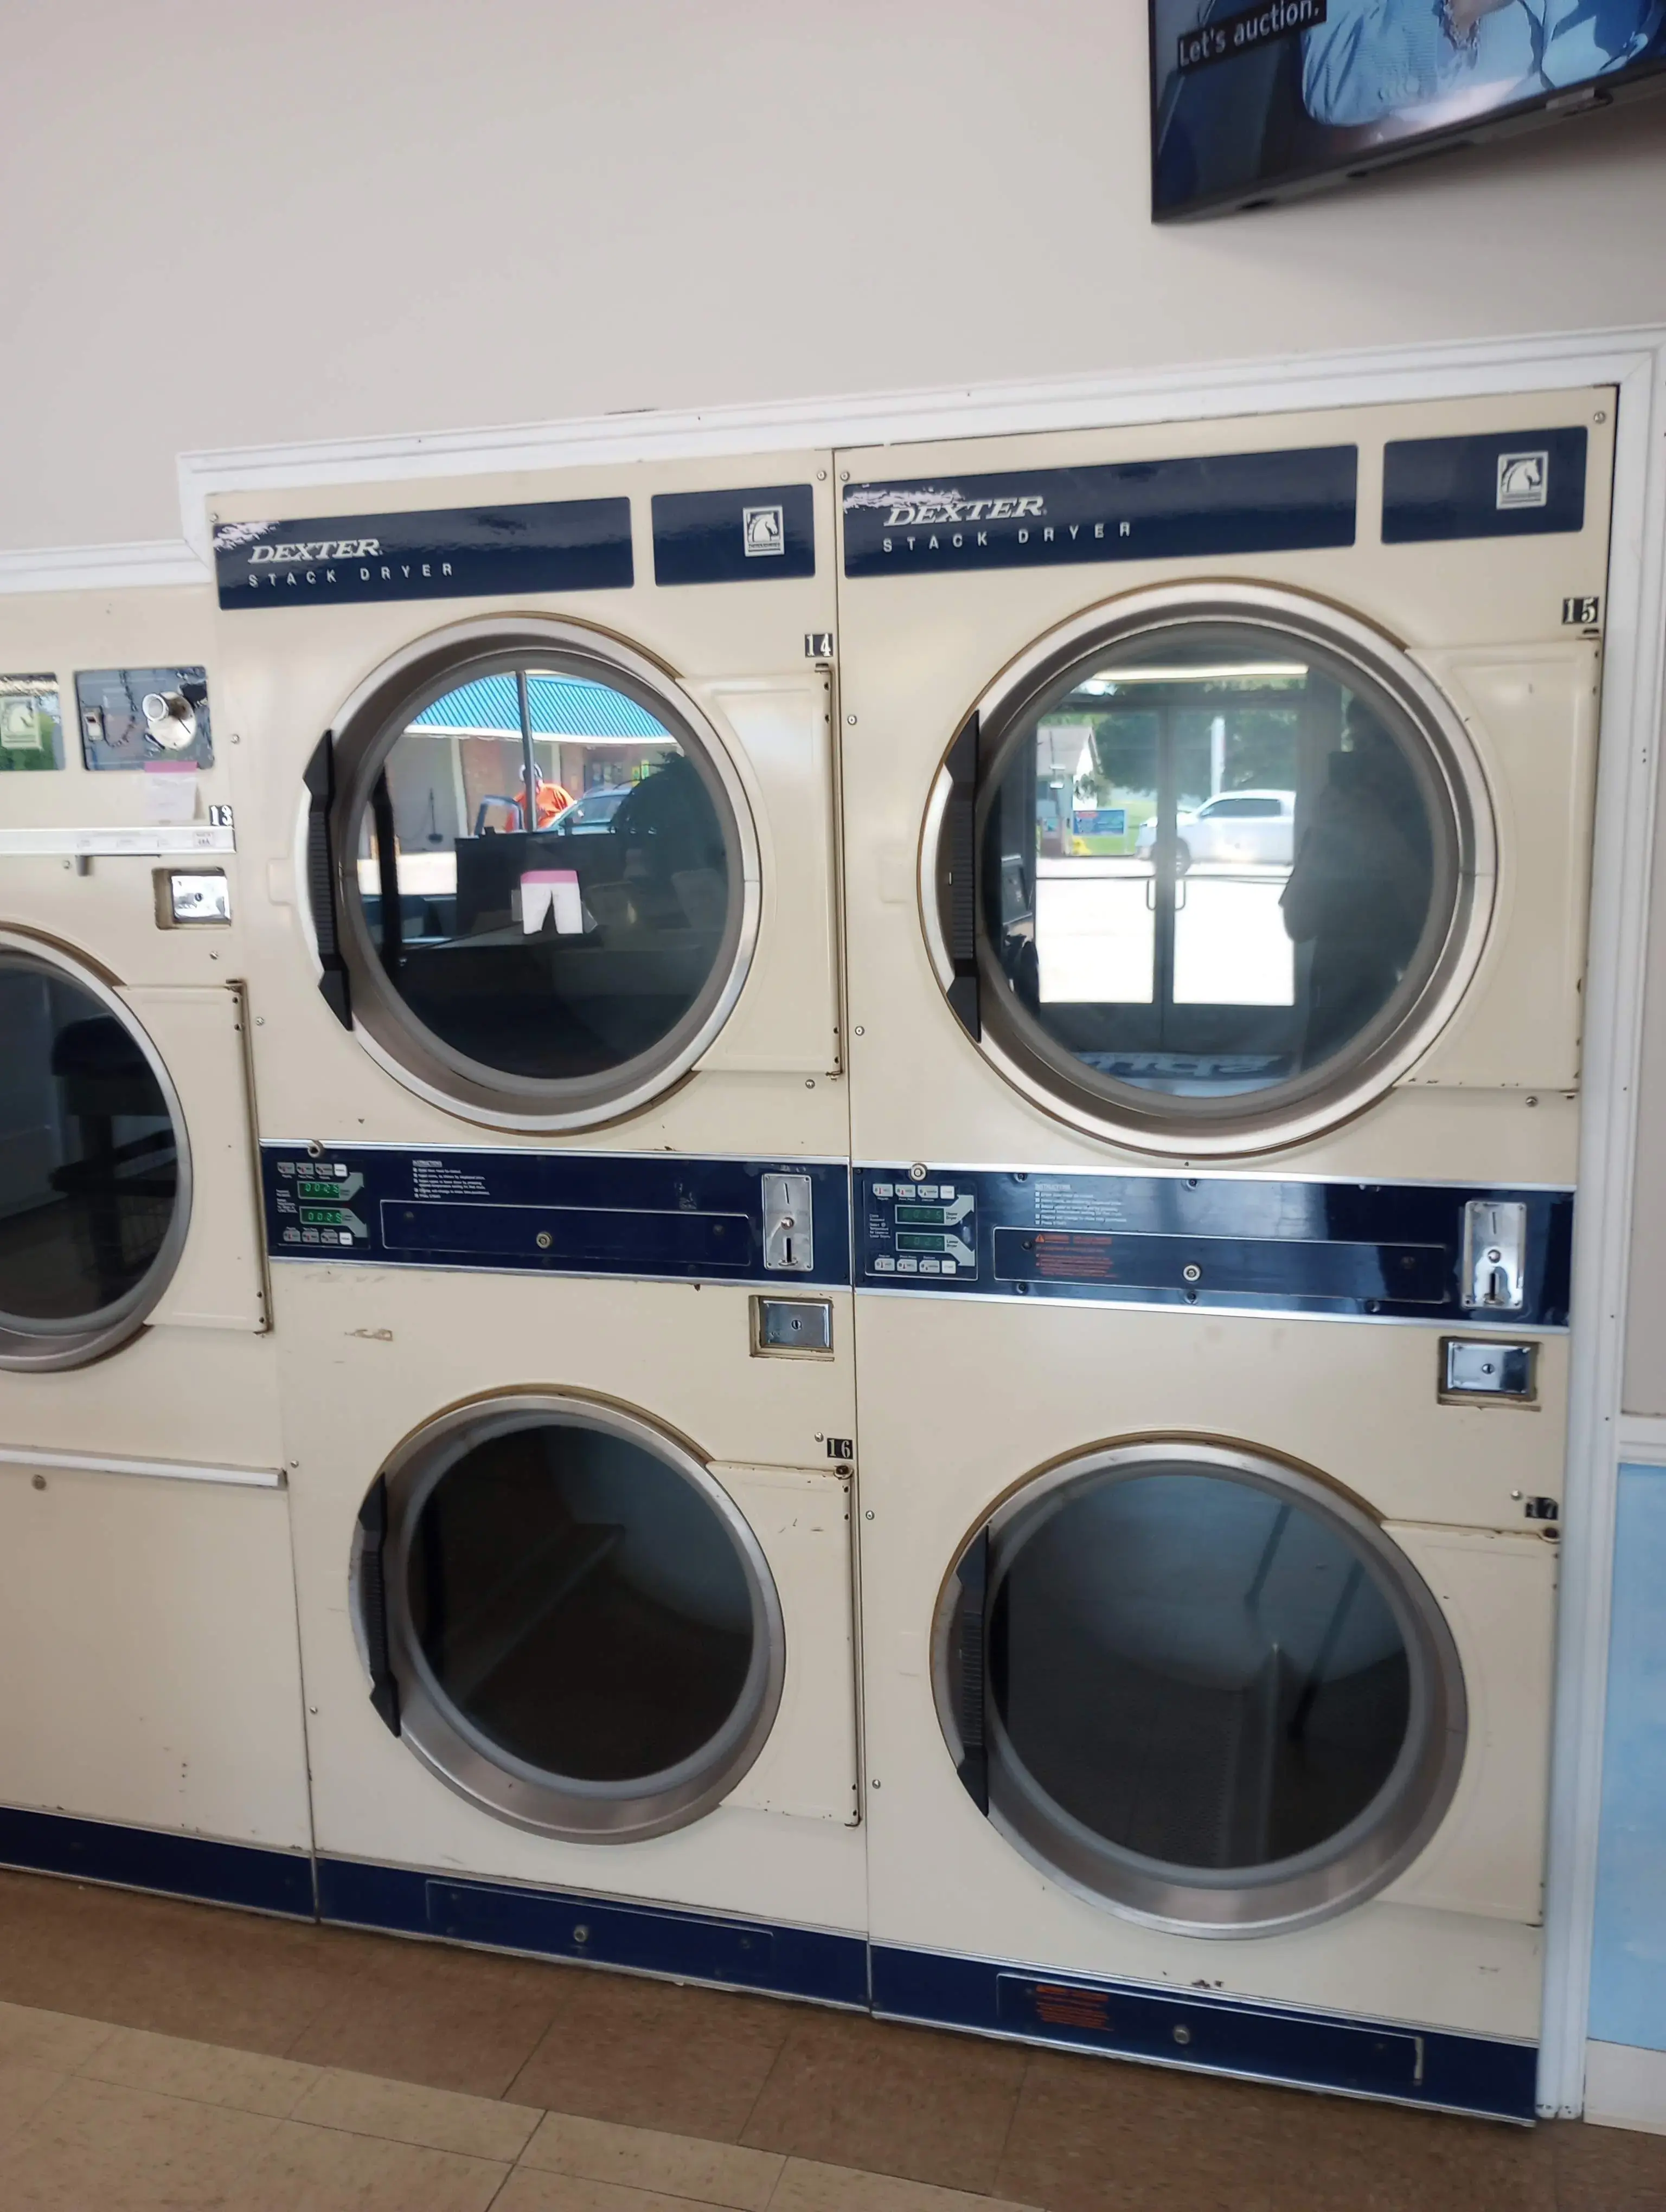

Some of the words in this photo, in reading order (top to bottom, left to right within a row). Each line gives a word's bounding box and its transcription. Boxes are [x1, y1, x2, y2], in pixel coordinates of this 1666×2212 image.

[1179, 27, 1226, 67] Let's
[1234, 0, 1319, 45] auction.
[883, 496, 1045, 527] DEXTER
[883, 532, 988, 553] STACK
[1018, 521, 1131, 544] DRYER
[247, 538, 380, 564] DEXTER
[248, 569, 337, 588] STACK
[360, 562, 453, 581] DRYER
[1564, 597, 1596, 623] 15
[806, 633, 832, 657] 14
[210, 805, 233, 826] 13
[829, 1439, 851, 1458] 16
